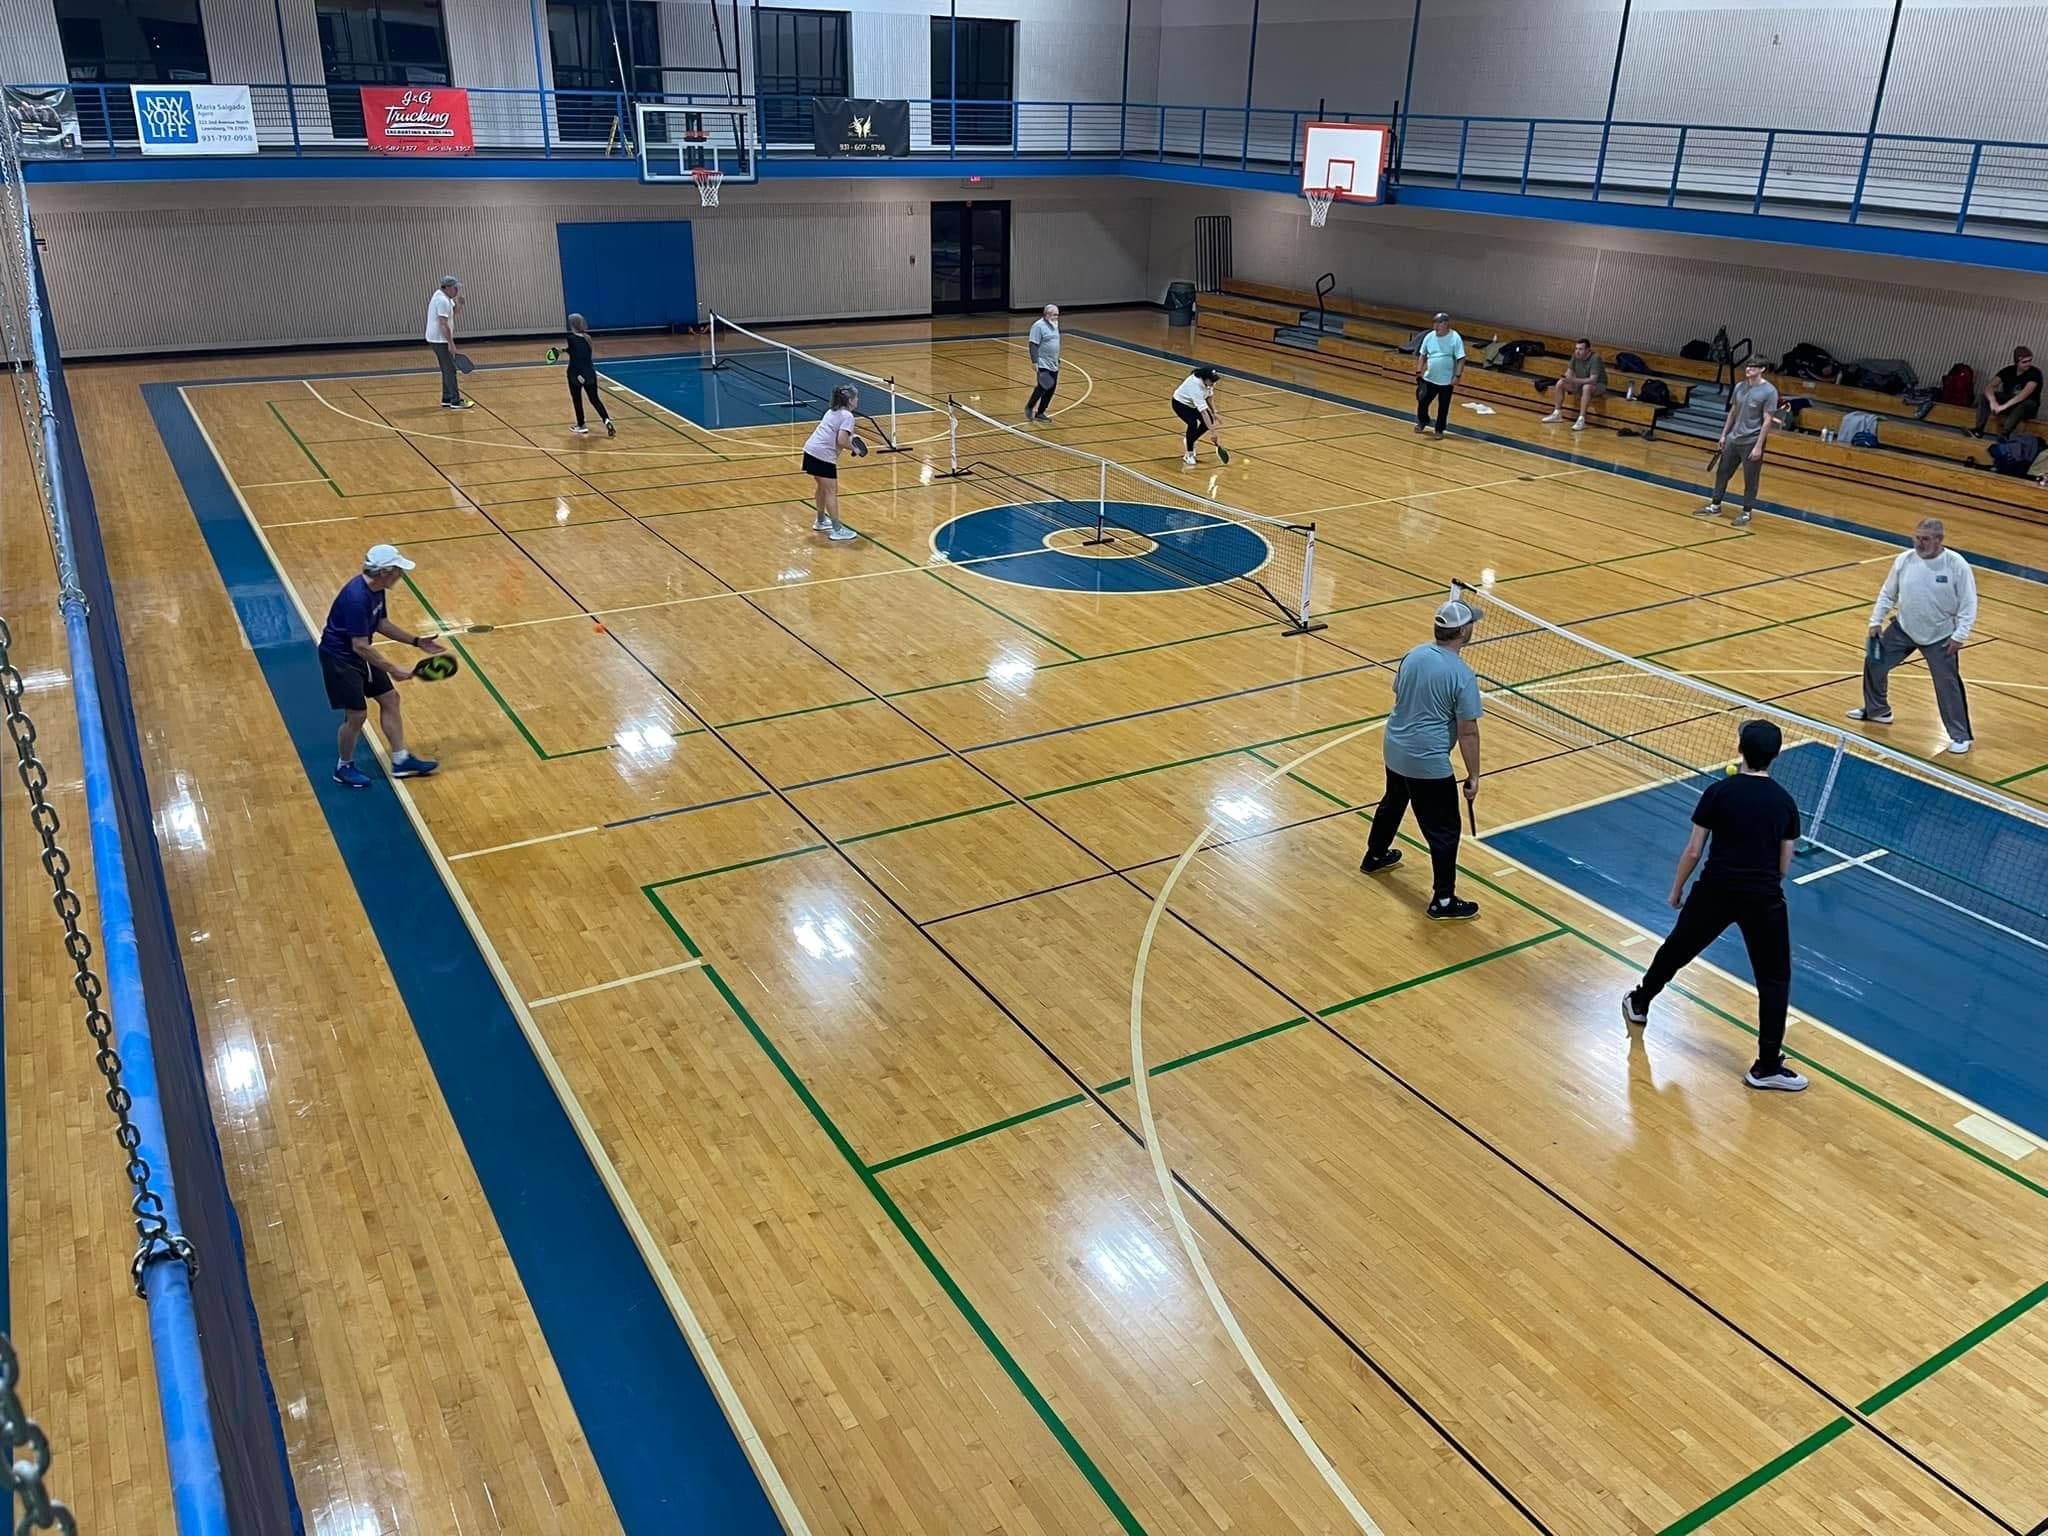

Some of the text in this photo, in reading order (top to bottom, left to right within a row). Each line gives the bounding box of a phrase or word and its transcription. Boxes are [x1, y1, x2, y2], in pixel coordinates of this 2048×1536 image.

[145, 96, 183, 111] NEW
[217, 103, 246, 112] Salgado
[141, 107, 192, 125] YORK
[384, 105, 450, 128] Trucking
[150, 123, 189, 138] LIFE
